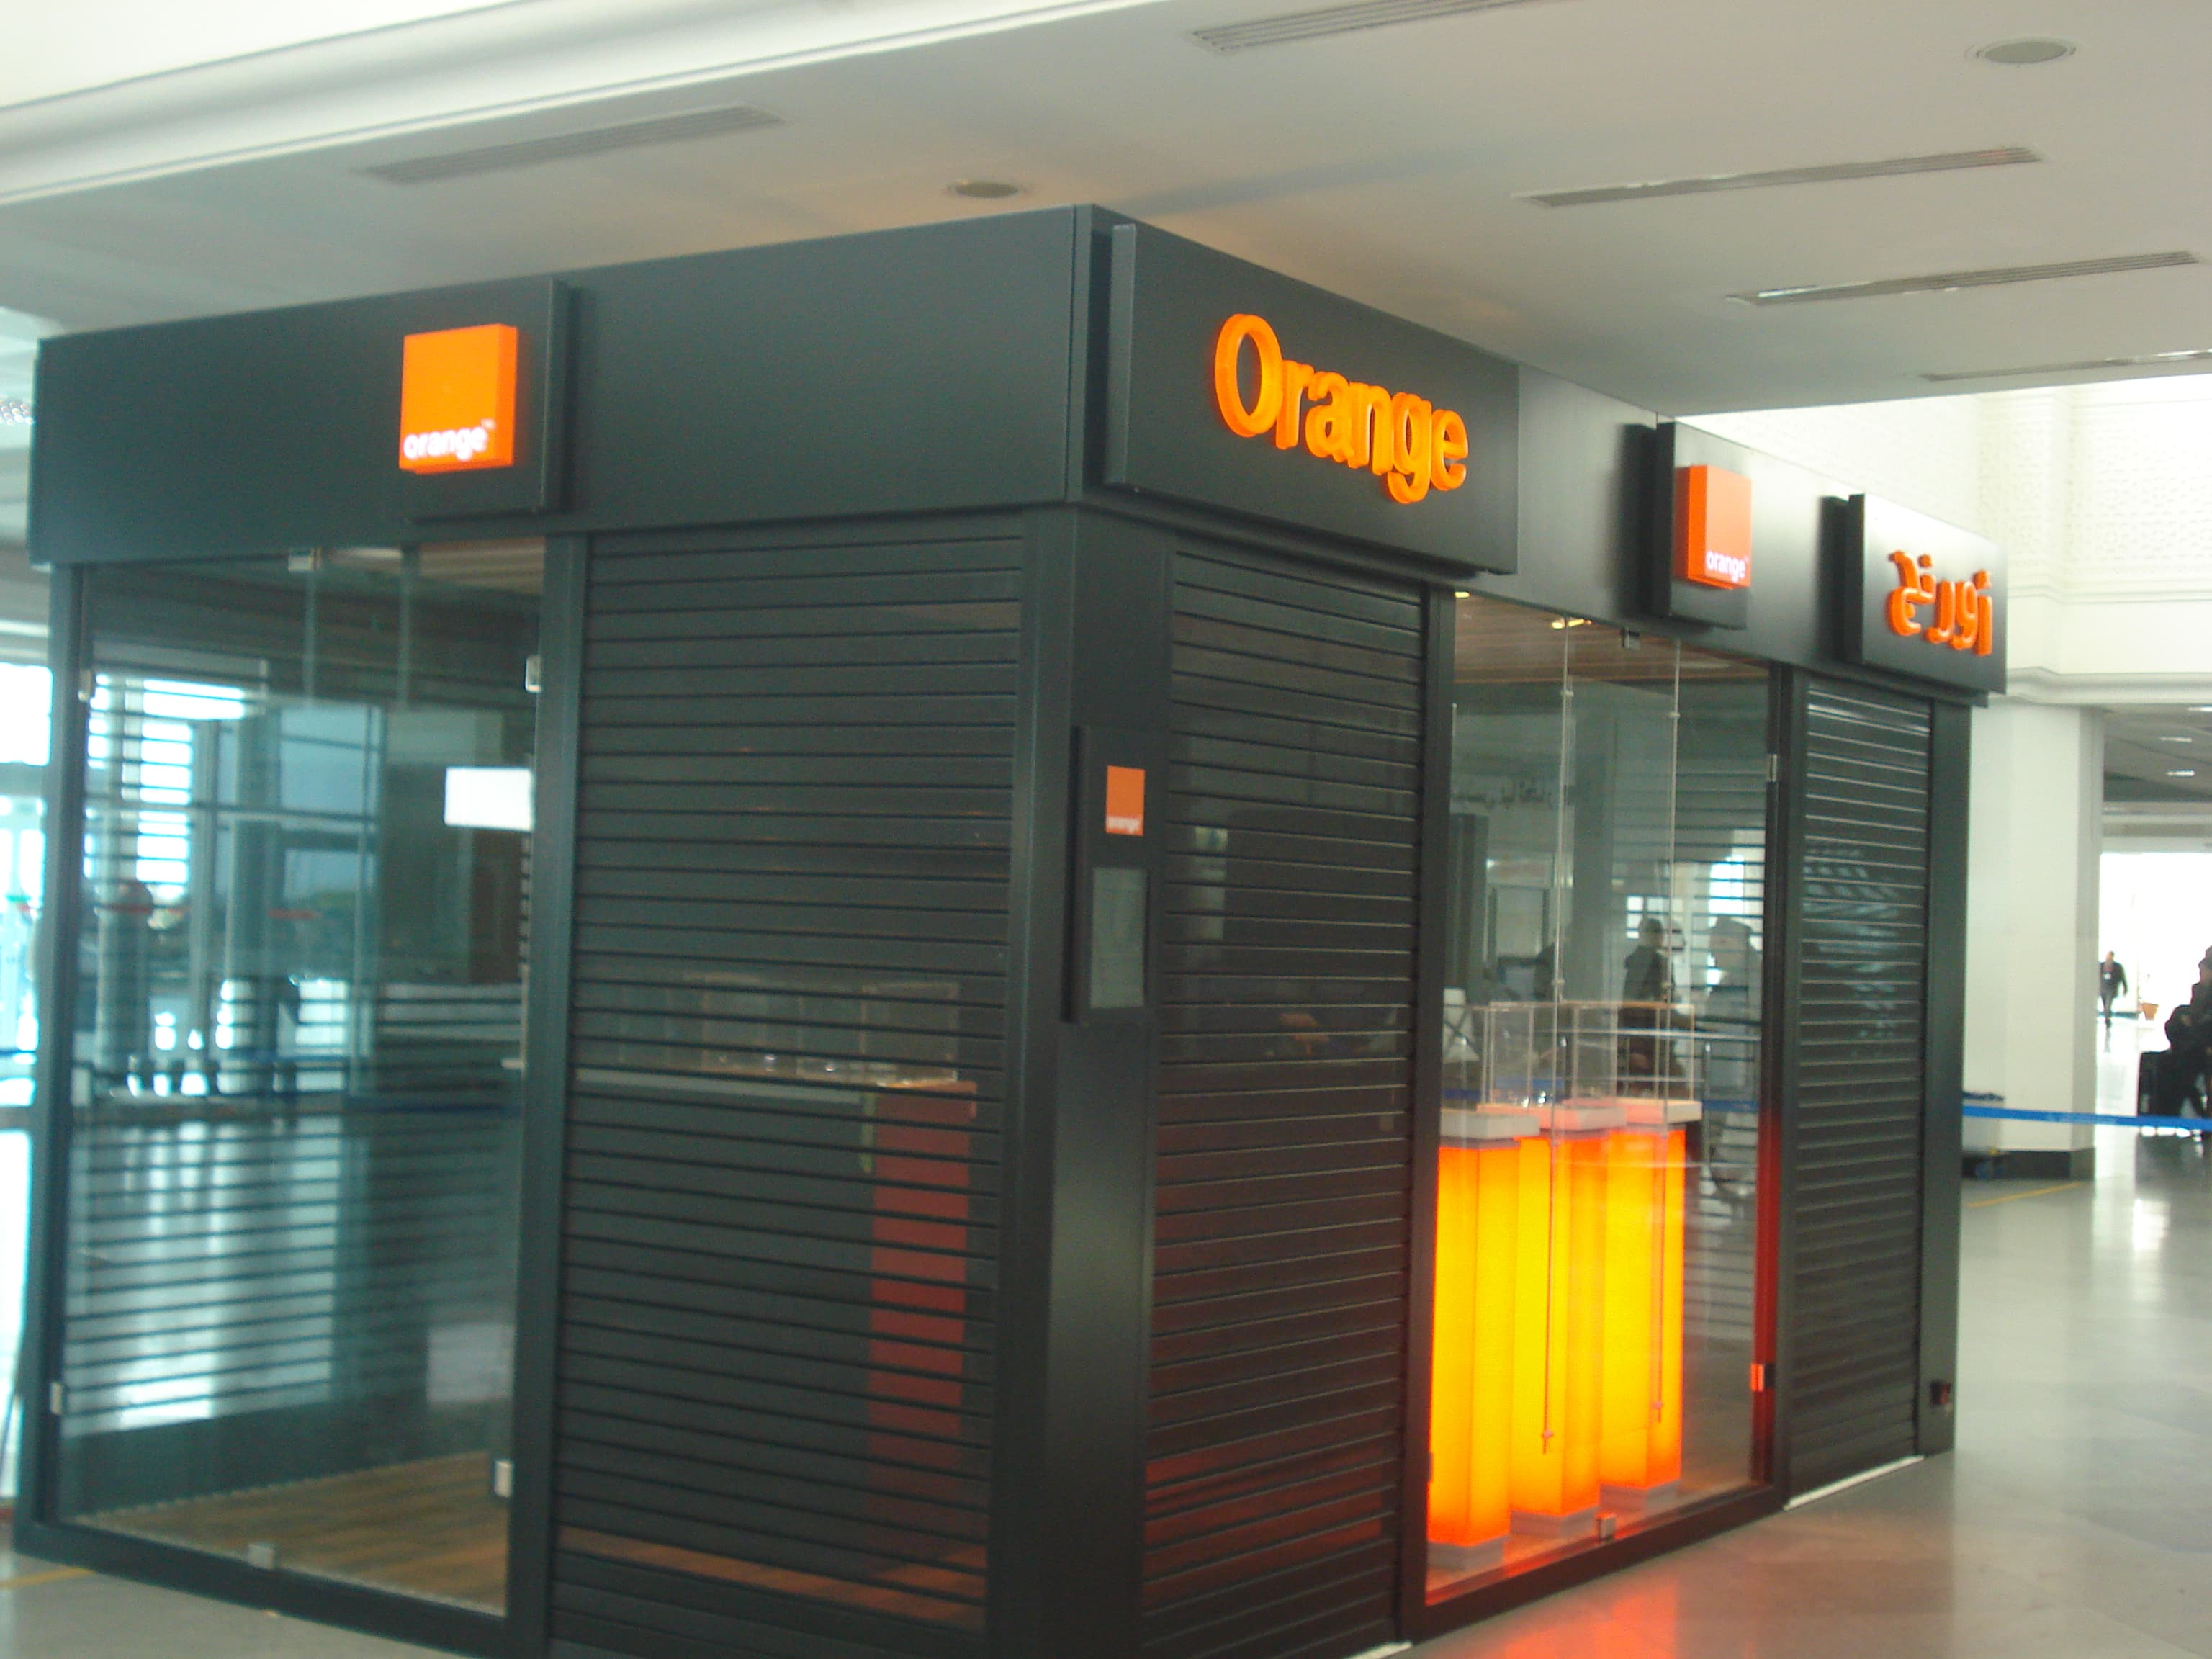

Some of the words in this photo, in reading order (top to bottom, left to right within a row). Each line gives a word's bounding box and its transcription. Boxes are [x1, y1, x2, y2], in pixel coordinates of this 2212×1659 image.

[1215, 313, 1469, 504] Orange
[403, 426, 488, 461] orange
[1706, 550, 1746, 583] orange
